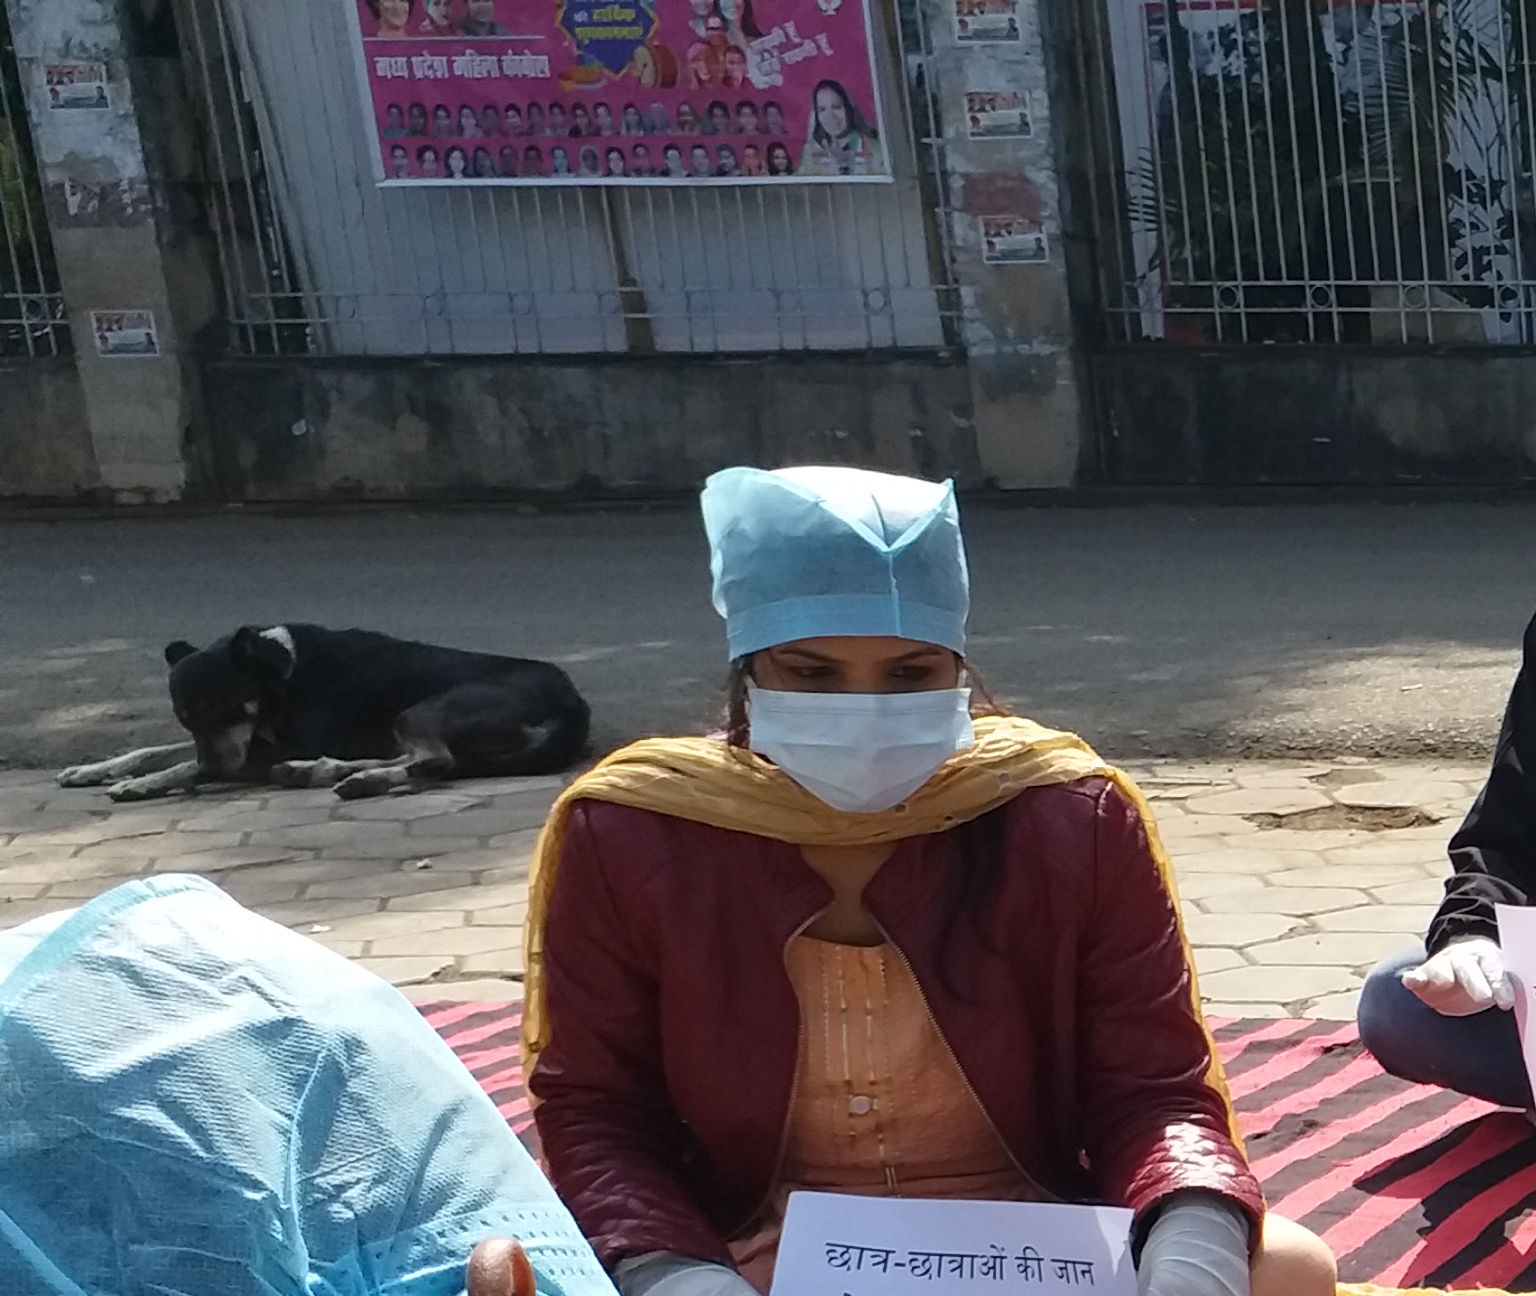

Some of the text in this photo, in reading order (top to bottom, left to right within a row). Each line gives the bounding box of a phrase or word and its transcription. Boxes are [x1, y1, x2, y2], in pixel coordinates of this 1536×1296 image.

[825, 1241, 1095, 1287] छात्र-छात्राओं की जान
